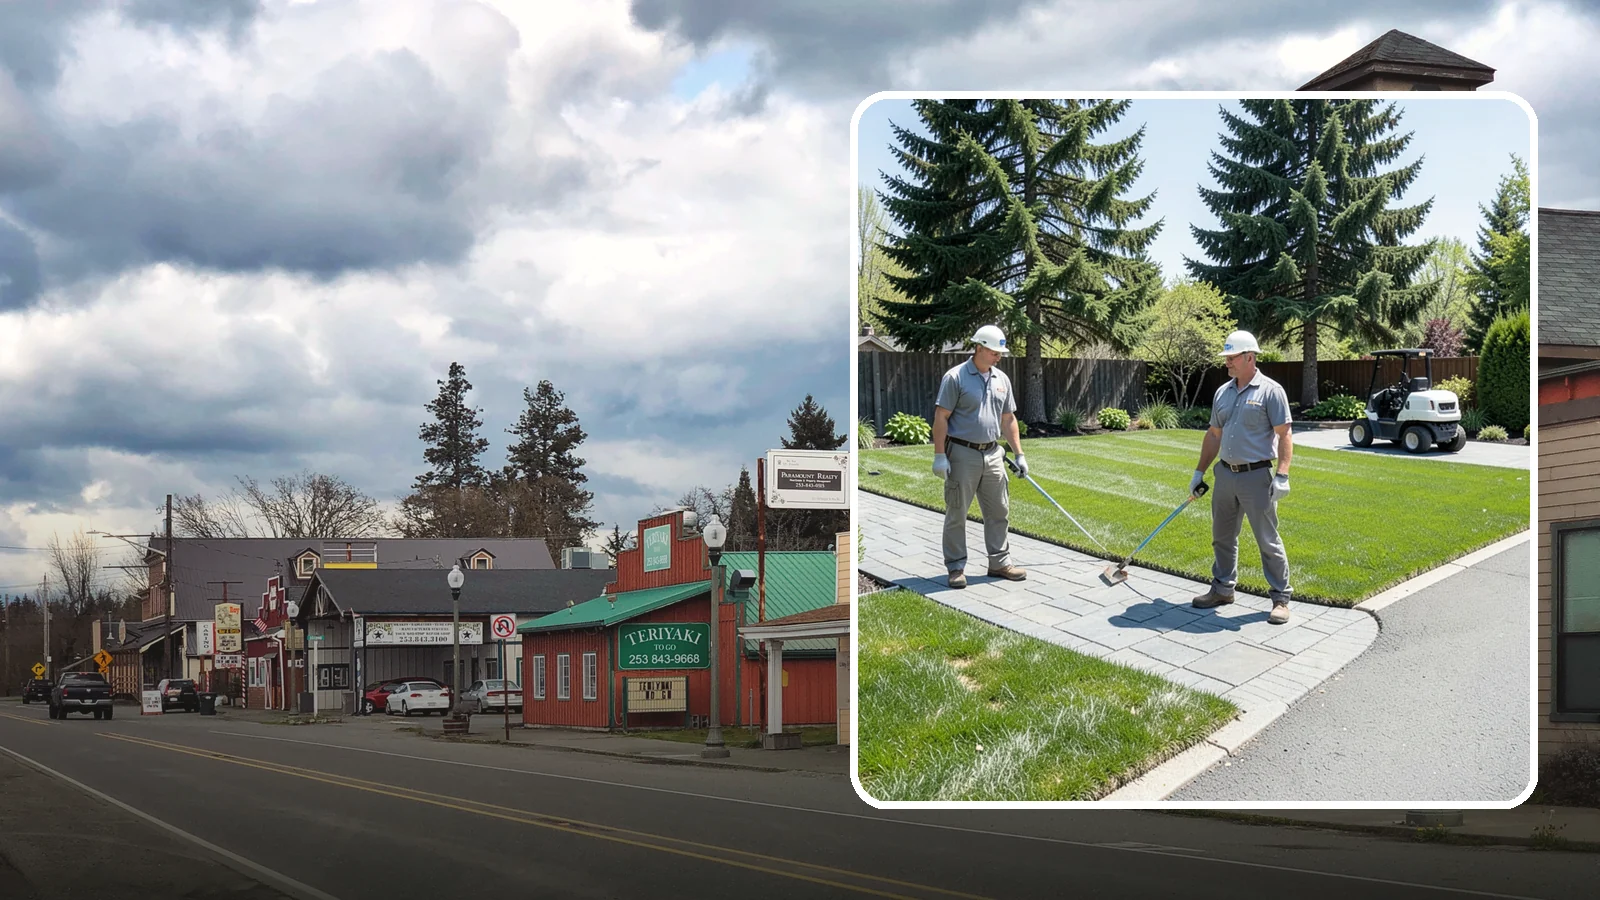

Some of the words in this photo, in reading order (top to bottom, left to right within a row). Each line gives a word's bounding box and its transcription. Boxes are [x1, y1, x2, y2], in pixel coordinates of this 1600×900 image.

[625, 627, 703, 646] TERIYAKI
[629, 654, 649, 665] 253
[651, 653, 700, 664] 843-9668
[639, 681, 672, 691] TERIYAKI
